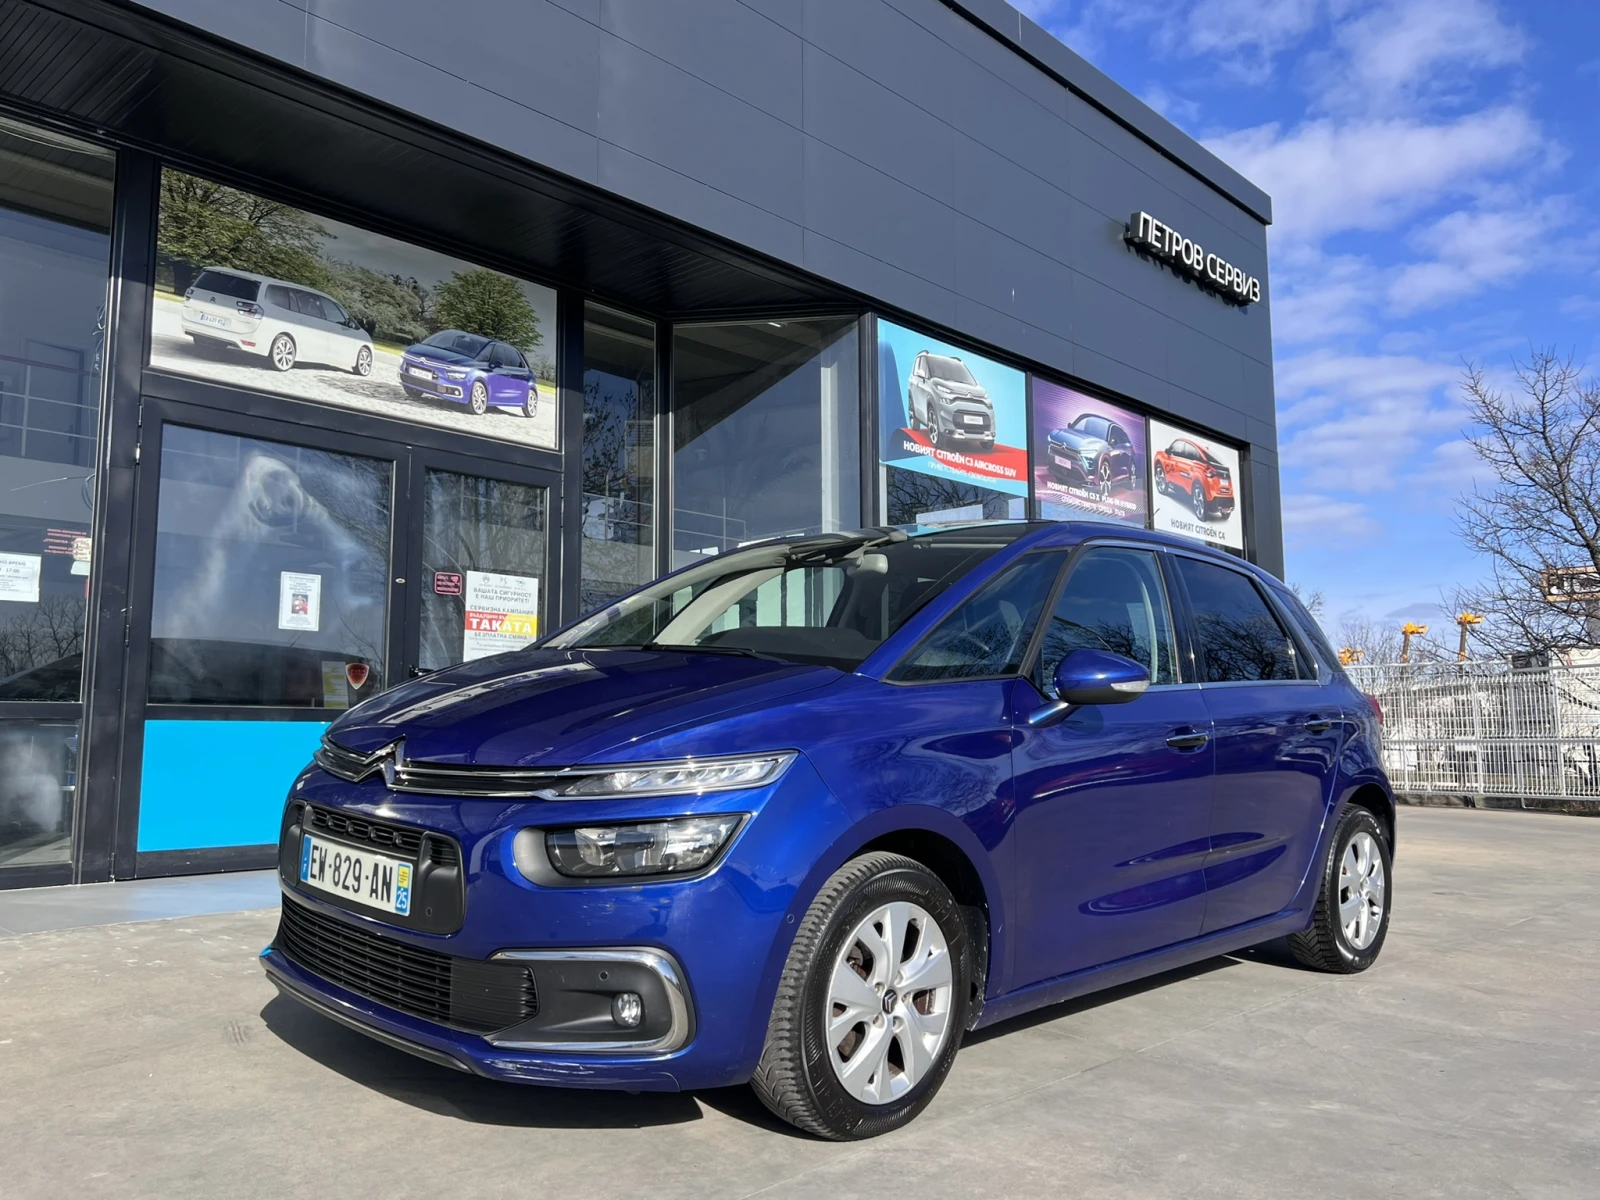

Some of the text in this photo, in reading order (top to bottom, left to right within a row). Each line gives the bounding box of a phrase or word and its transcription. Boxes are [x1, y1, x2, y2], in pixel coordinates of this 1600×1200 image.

[1138, 210, 1261, 303] ПЕТРОВ СЕРВИЗ
[903, 440, 1017, 478] НОВИЯТ CITROËN C3 AIRCROSS SUV
[1047, 481, 1068, 494] НОВИЯТ
[1170, 518, 1226, 540] НОВИЯТ CITROËN C4
[473, 587, 498, 595] ВАШАТА
[498, 589, 532, 598] СИГУРНОСТ
[495, 595, 530, 604] ПРИОРИТЕТ!
[469, 604, 502, 613] СЕРВИЗНА
[469, 618, 533, 634] ТАКАТА
[474, 632, 508, 640] БЕЗПЛАТНА
[310, 844, 393, 904] EW-829-AN
[396, 891, 408, 909] 25
